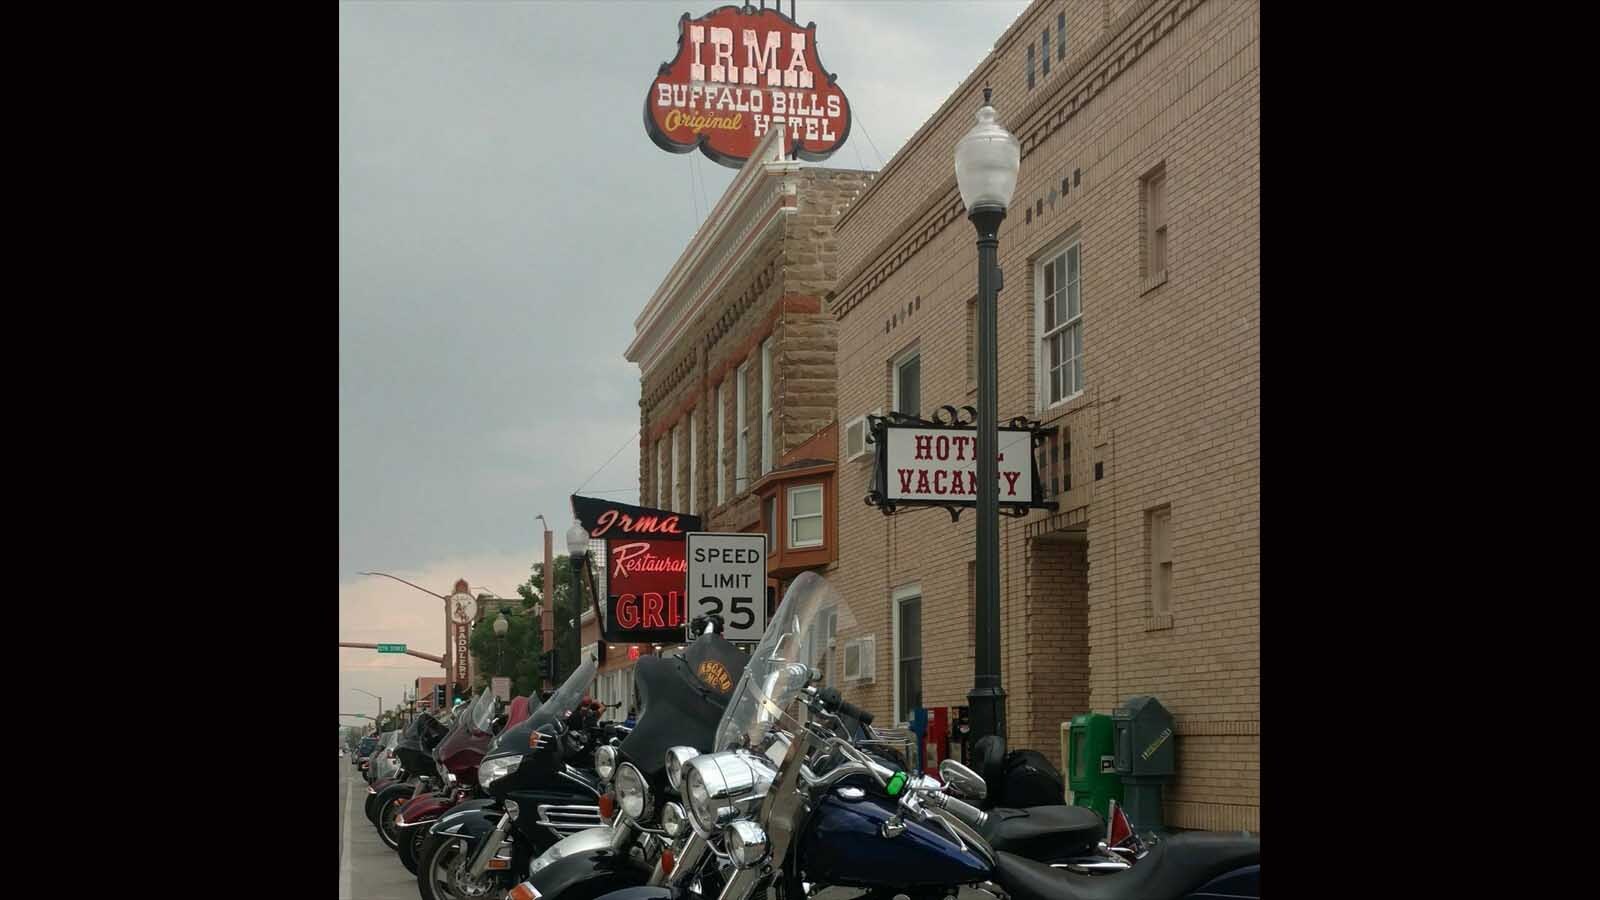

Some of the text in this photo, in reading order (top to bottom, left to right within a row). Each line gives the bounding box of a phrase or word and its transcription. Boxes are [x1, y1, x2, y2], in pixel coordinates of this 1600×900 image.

[690, 25, 813, 88] IRMA
[658, 83, 840, 117] BUFFALO BILLS
[664, 109, 742, 133] Original
[914, 435, 1004, 462] HOT
[592, 510, 683, 537] Irma
[612, 542, 687, 578] Restauran
[694, 548, 760, 564] SPEED
[701, 574, 752, 589] LIMIT
[616, 591, 687, 629] GRI
[458, 625, 467, 679] SADDLERY
